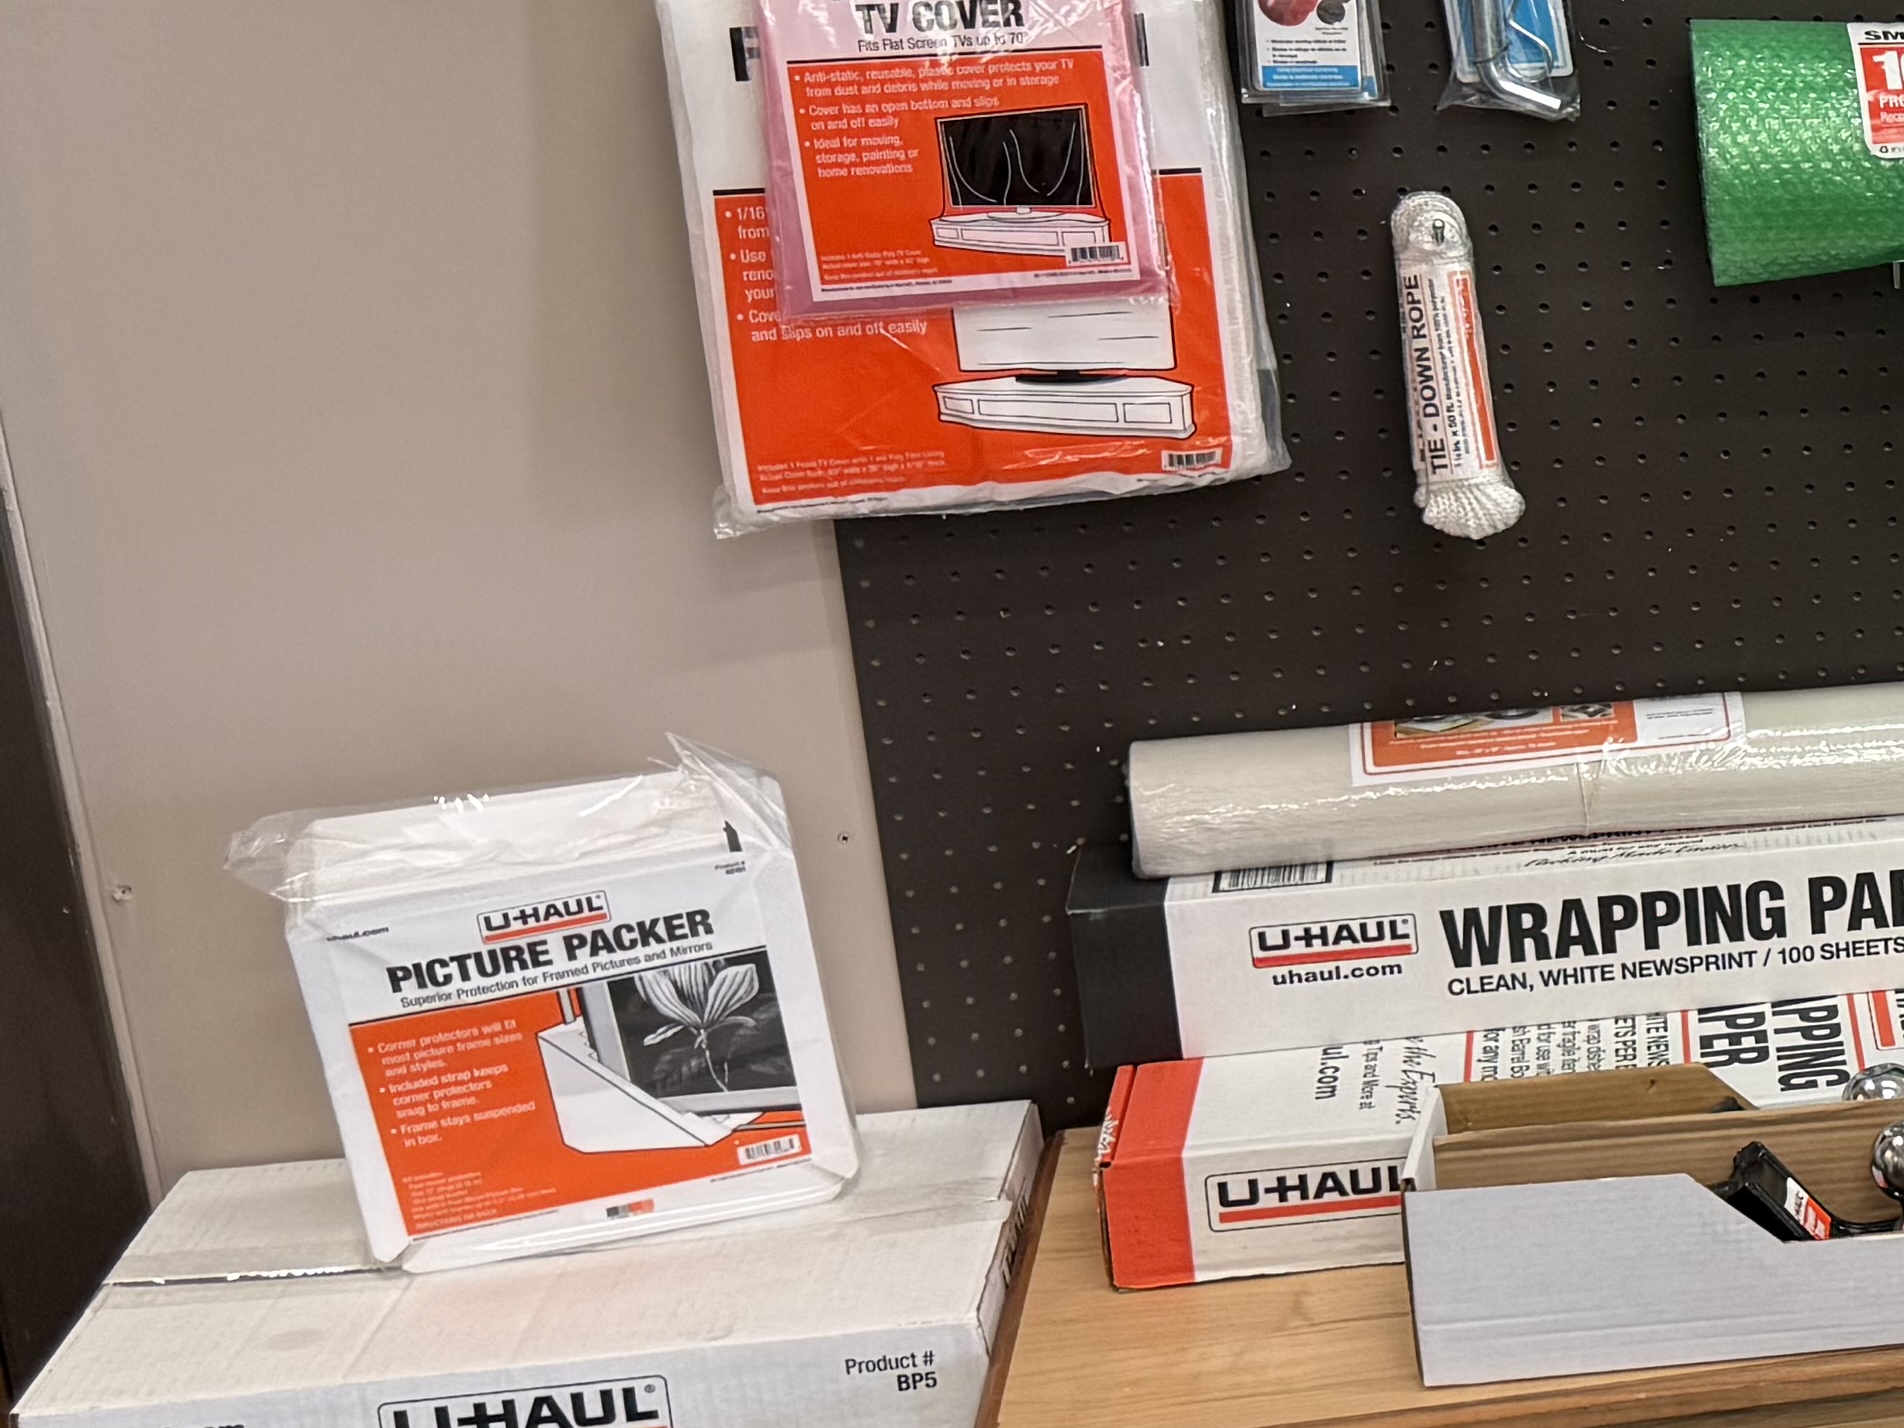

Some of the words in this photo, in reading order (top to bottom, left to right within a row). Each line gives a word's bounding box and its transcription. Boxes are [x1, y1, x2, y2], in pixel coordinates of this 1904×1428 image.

[856, 4, 899, 35] TV
[1403, 275, 1426, 340] ROPE
[1414, 347, 1440, 419] DOWN
[1428, 438, 1448, 475] TIE
[1439, 880, 1786, 968] WRAPPING
[386, 940, 554, 994] PICTURE
[564, 908, 714, 960] PACKER
[1447, 971, 1535, 996] CLEAN,
[1540, 963, 1616, 989] WHITE
[1620, 950, 1759, 981] NEWSPRINT
[1778, 944, 1814, 964] 100
[1272, 963, 1402, 986] uhaul.com
[844, 1353, 915, 1376] Product
[921, 1352, 935, 1367] #
[896, 1371, 938, 1392] BP5
